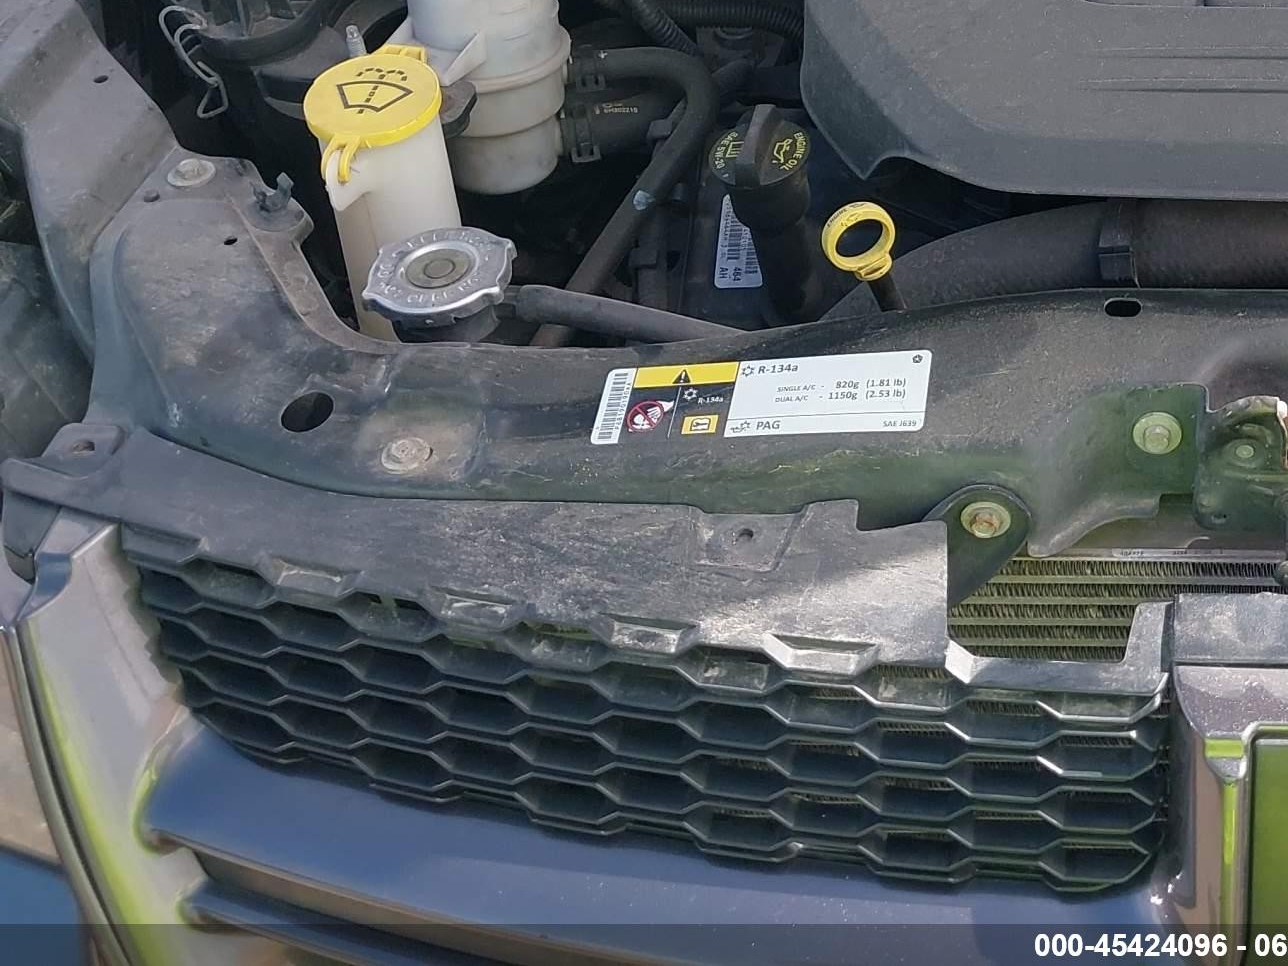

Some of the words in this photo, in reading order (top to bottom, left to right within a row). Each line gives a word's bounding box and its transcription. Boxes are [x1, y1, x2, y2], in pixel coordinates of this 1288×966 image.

[793, 132, 806, 159] ENGINE
[780, 159, 798, 171] OIL
[757, 362, 799, 375] R-134a
[776, 384, 801, 393] SINGLE
[802, 384, 817, 392] A/C
[836, 380, 860, 390] 820g
[866, 378, 891, 389] (1.81
[893, 377, 907, 388] lb)
[828, 391, 859, 401] 1150g
[865, 390, 891, 400] (2.53
[892, 388, 906, 399] lb)
[756, 419, 781, 430] PAG
